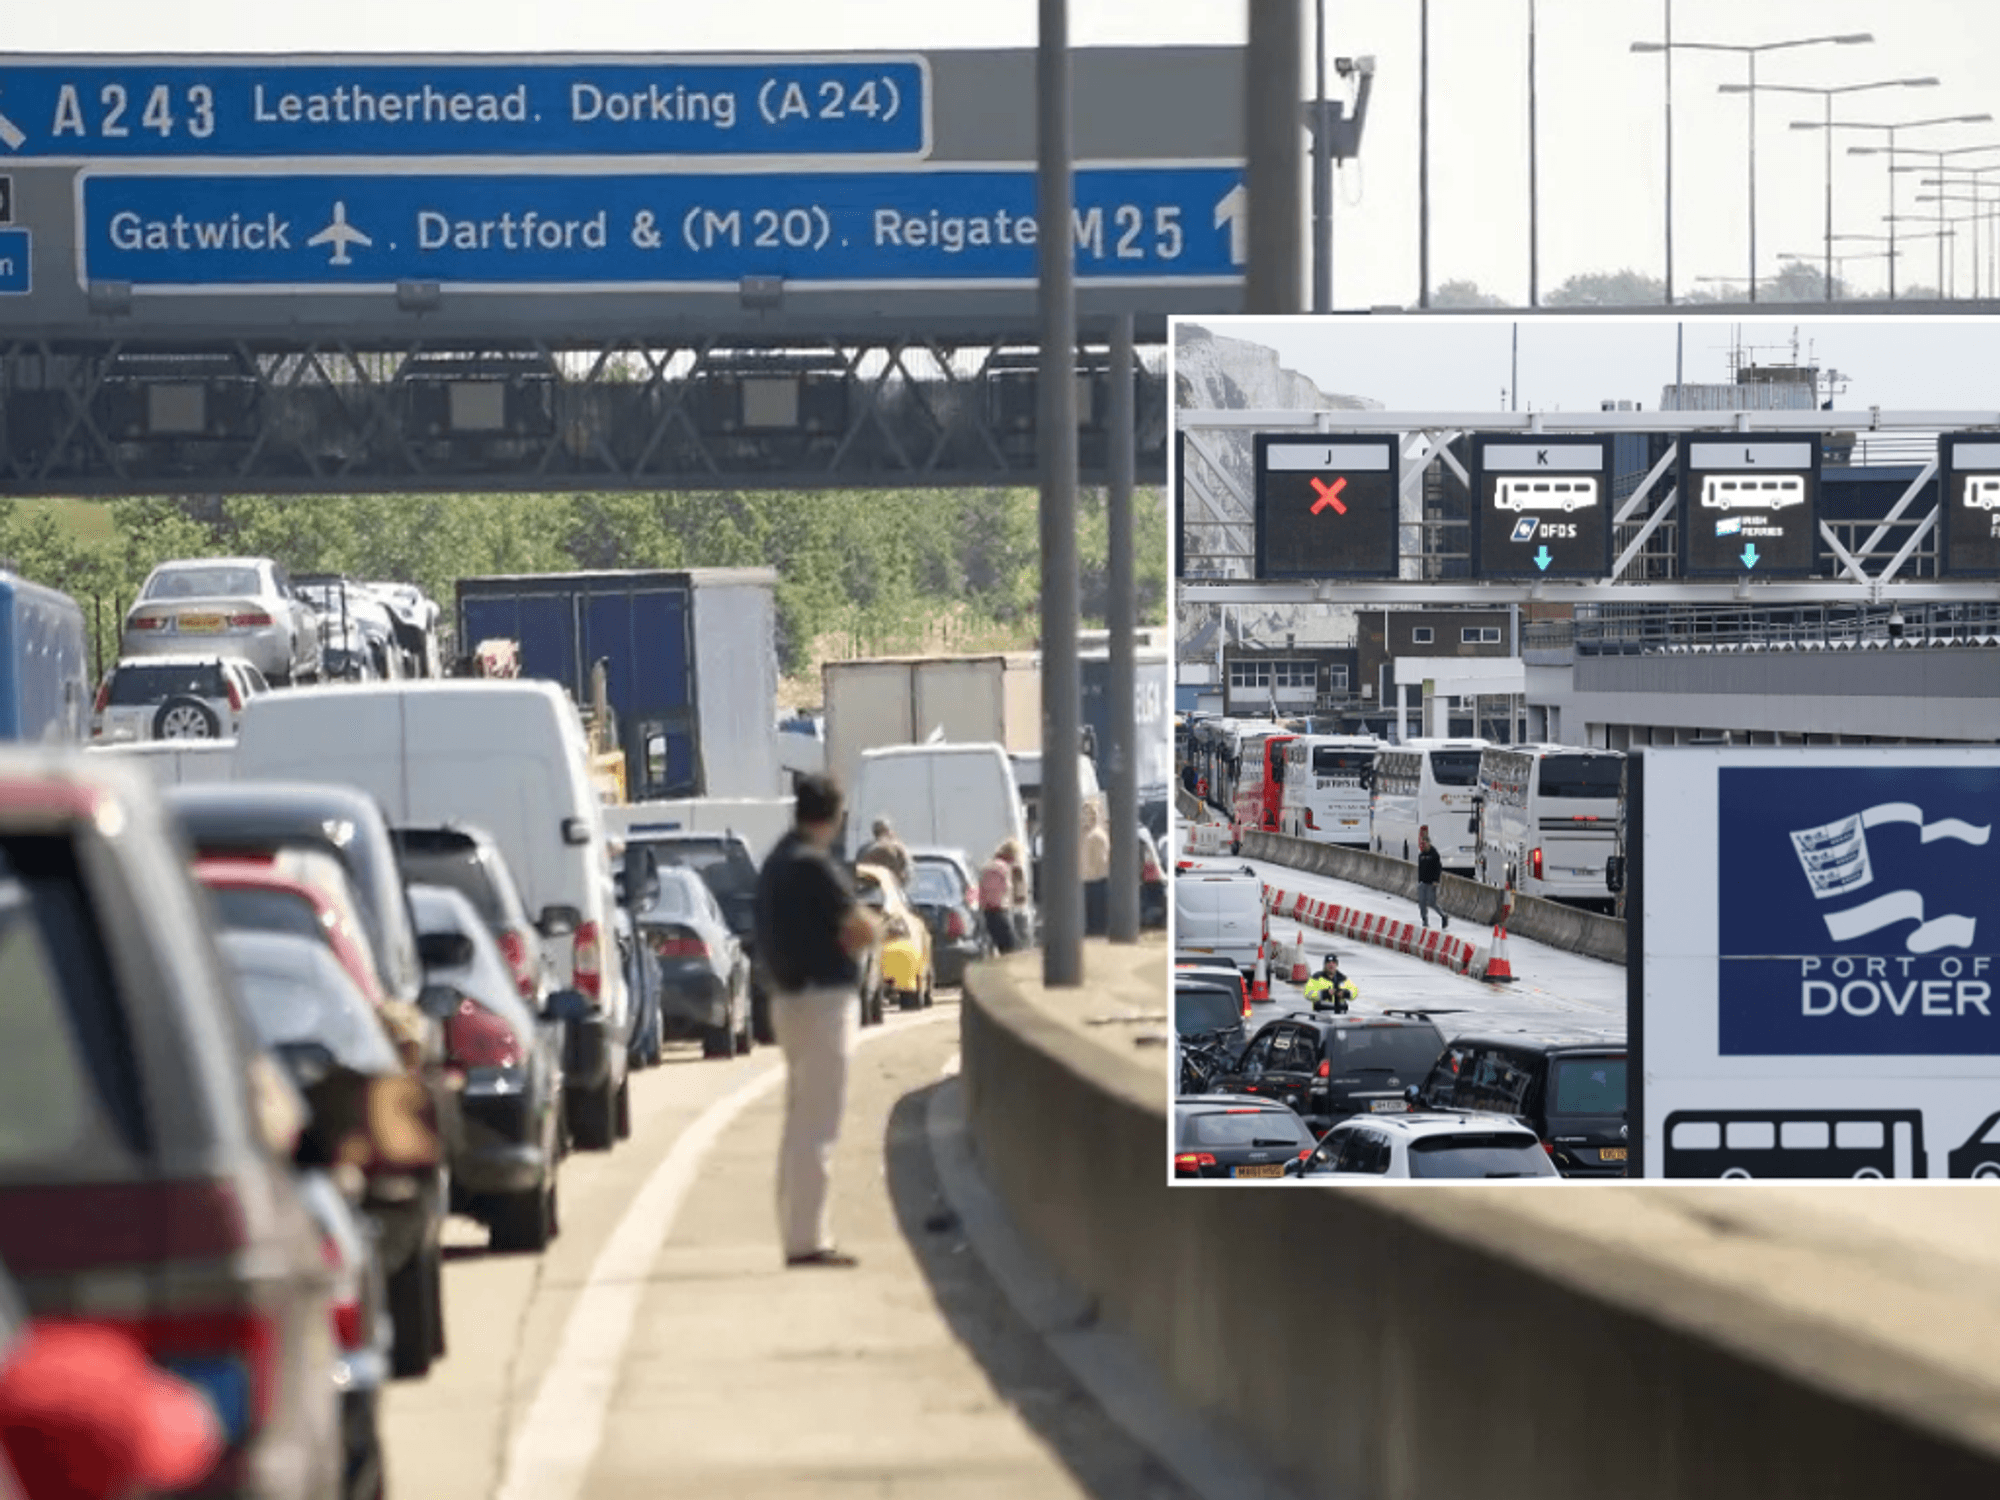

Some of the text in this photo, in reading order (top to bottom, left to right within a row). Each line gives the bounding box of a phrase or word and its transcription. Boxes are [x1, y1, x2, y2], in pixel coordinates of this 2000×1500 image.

[52, 85, 214, 136] A243
[571, 83, 736, 127] Dorking
[110, 212, 290, 249] Gatwick
[418, 211, 606, 249] Dartford
[632, 210, 661, 248] &
[874, 209, 1040, 252] Reigate
[1070, 205, 1182, 259] M25
[1324, 449, 1332, 465] J
[1537, 450, 1549, 465] K
[1745, 449, 1755, 464] L
[1801, 956, 1992, 978] PORT OF
[1802, 980, 1992, 1016] DOVER
